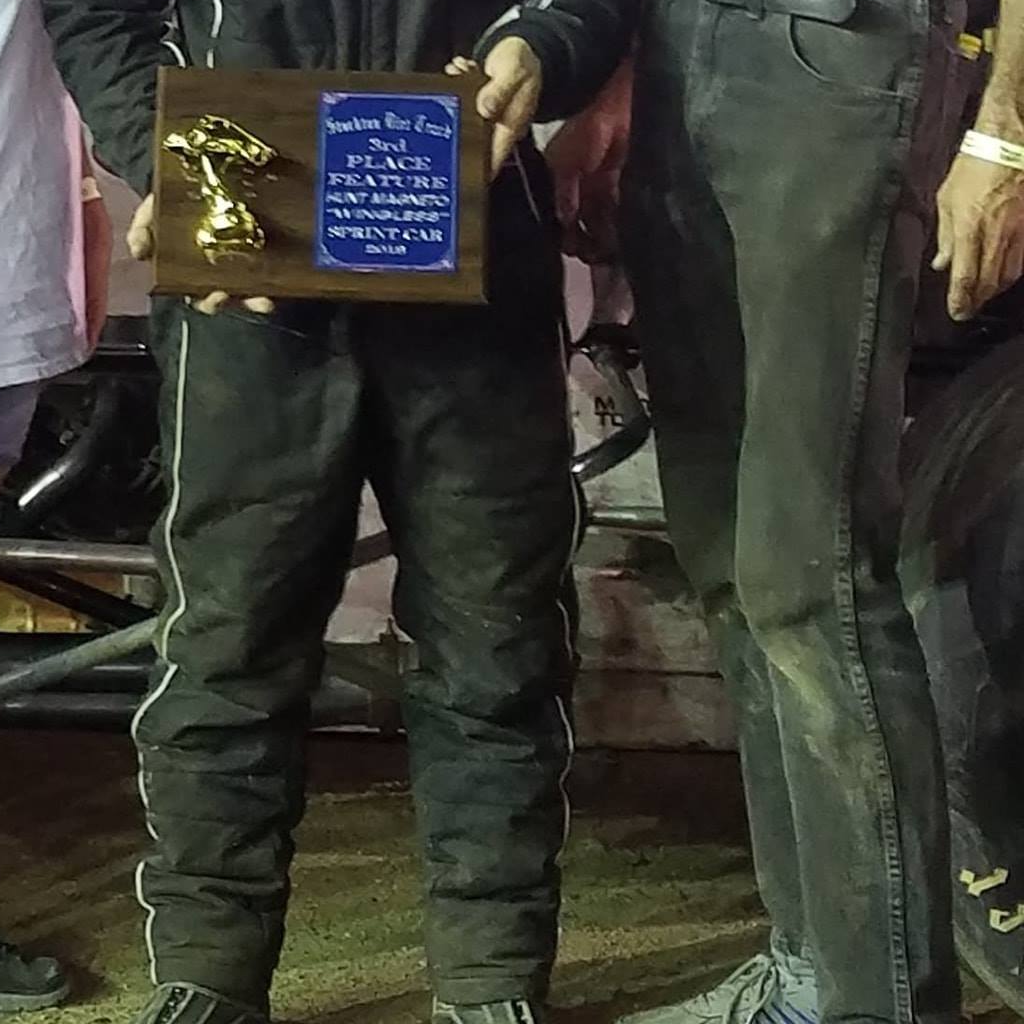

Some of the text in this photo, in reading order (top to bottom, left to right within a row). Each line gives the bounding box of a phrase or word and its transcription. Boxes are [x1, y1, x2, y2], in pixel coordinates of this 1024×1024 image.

[345, 154, 432, 171] PLACE
[327, 173, 449, 189] FEATURE
[327, 226, 444, 242] SPRINT CAR
